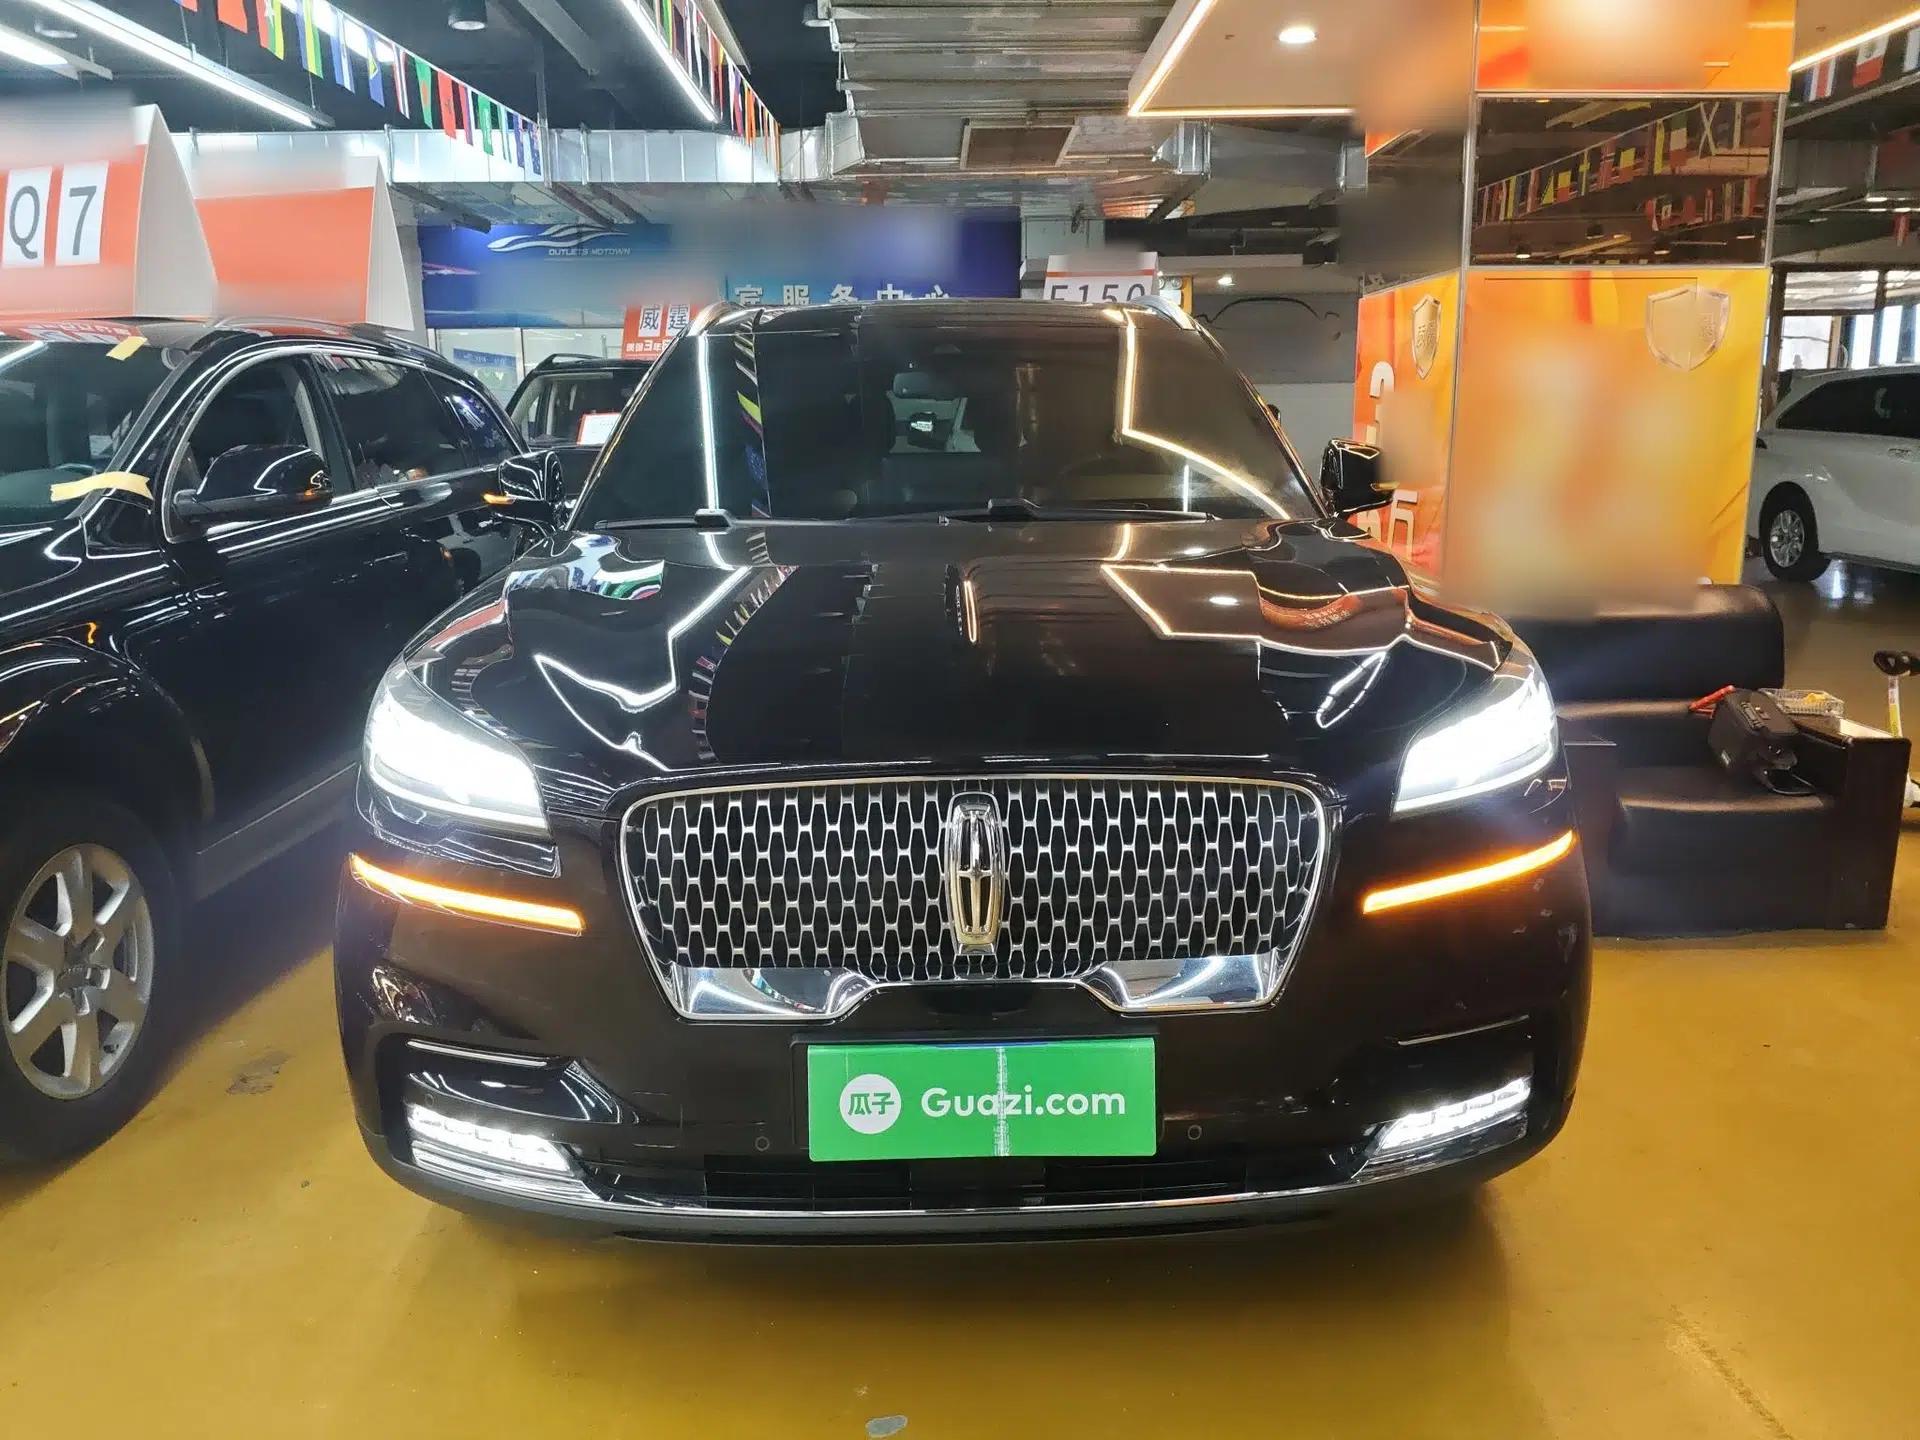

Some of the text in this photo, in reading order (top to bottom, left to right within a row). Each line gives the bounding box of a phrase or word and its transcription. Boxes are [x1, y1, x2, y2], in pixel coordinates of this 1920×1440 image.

[548, 247, 632, 257] OUTLETS MOTOWN
[848, 1092, 895, 1116] 瓜子
[921, 1084, 1126, 1118] Guazi.com
